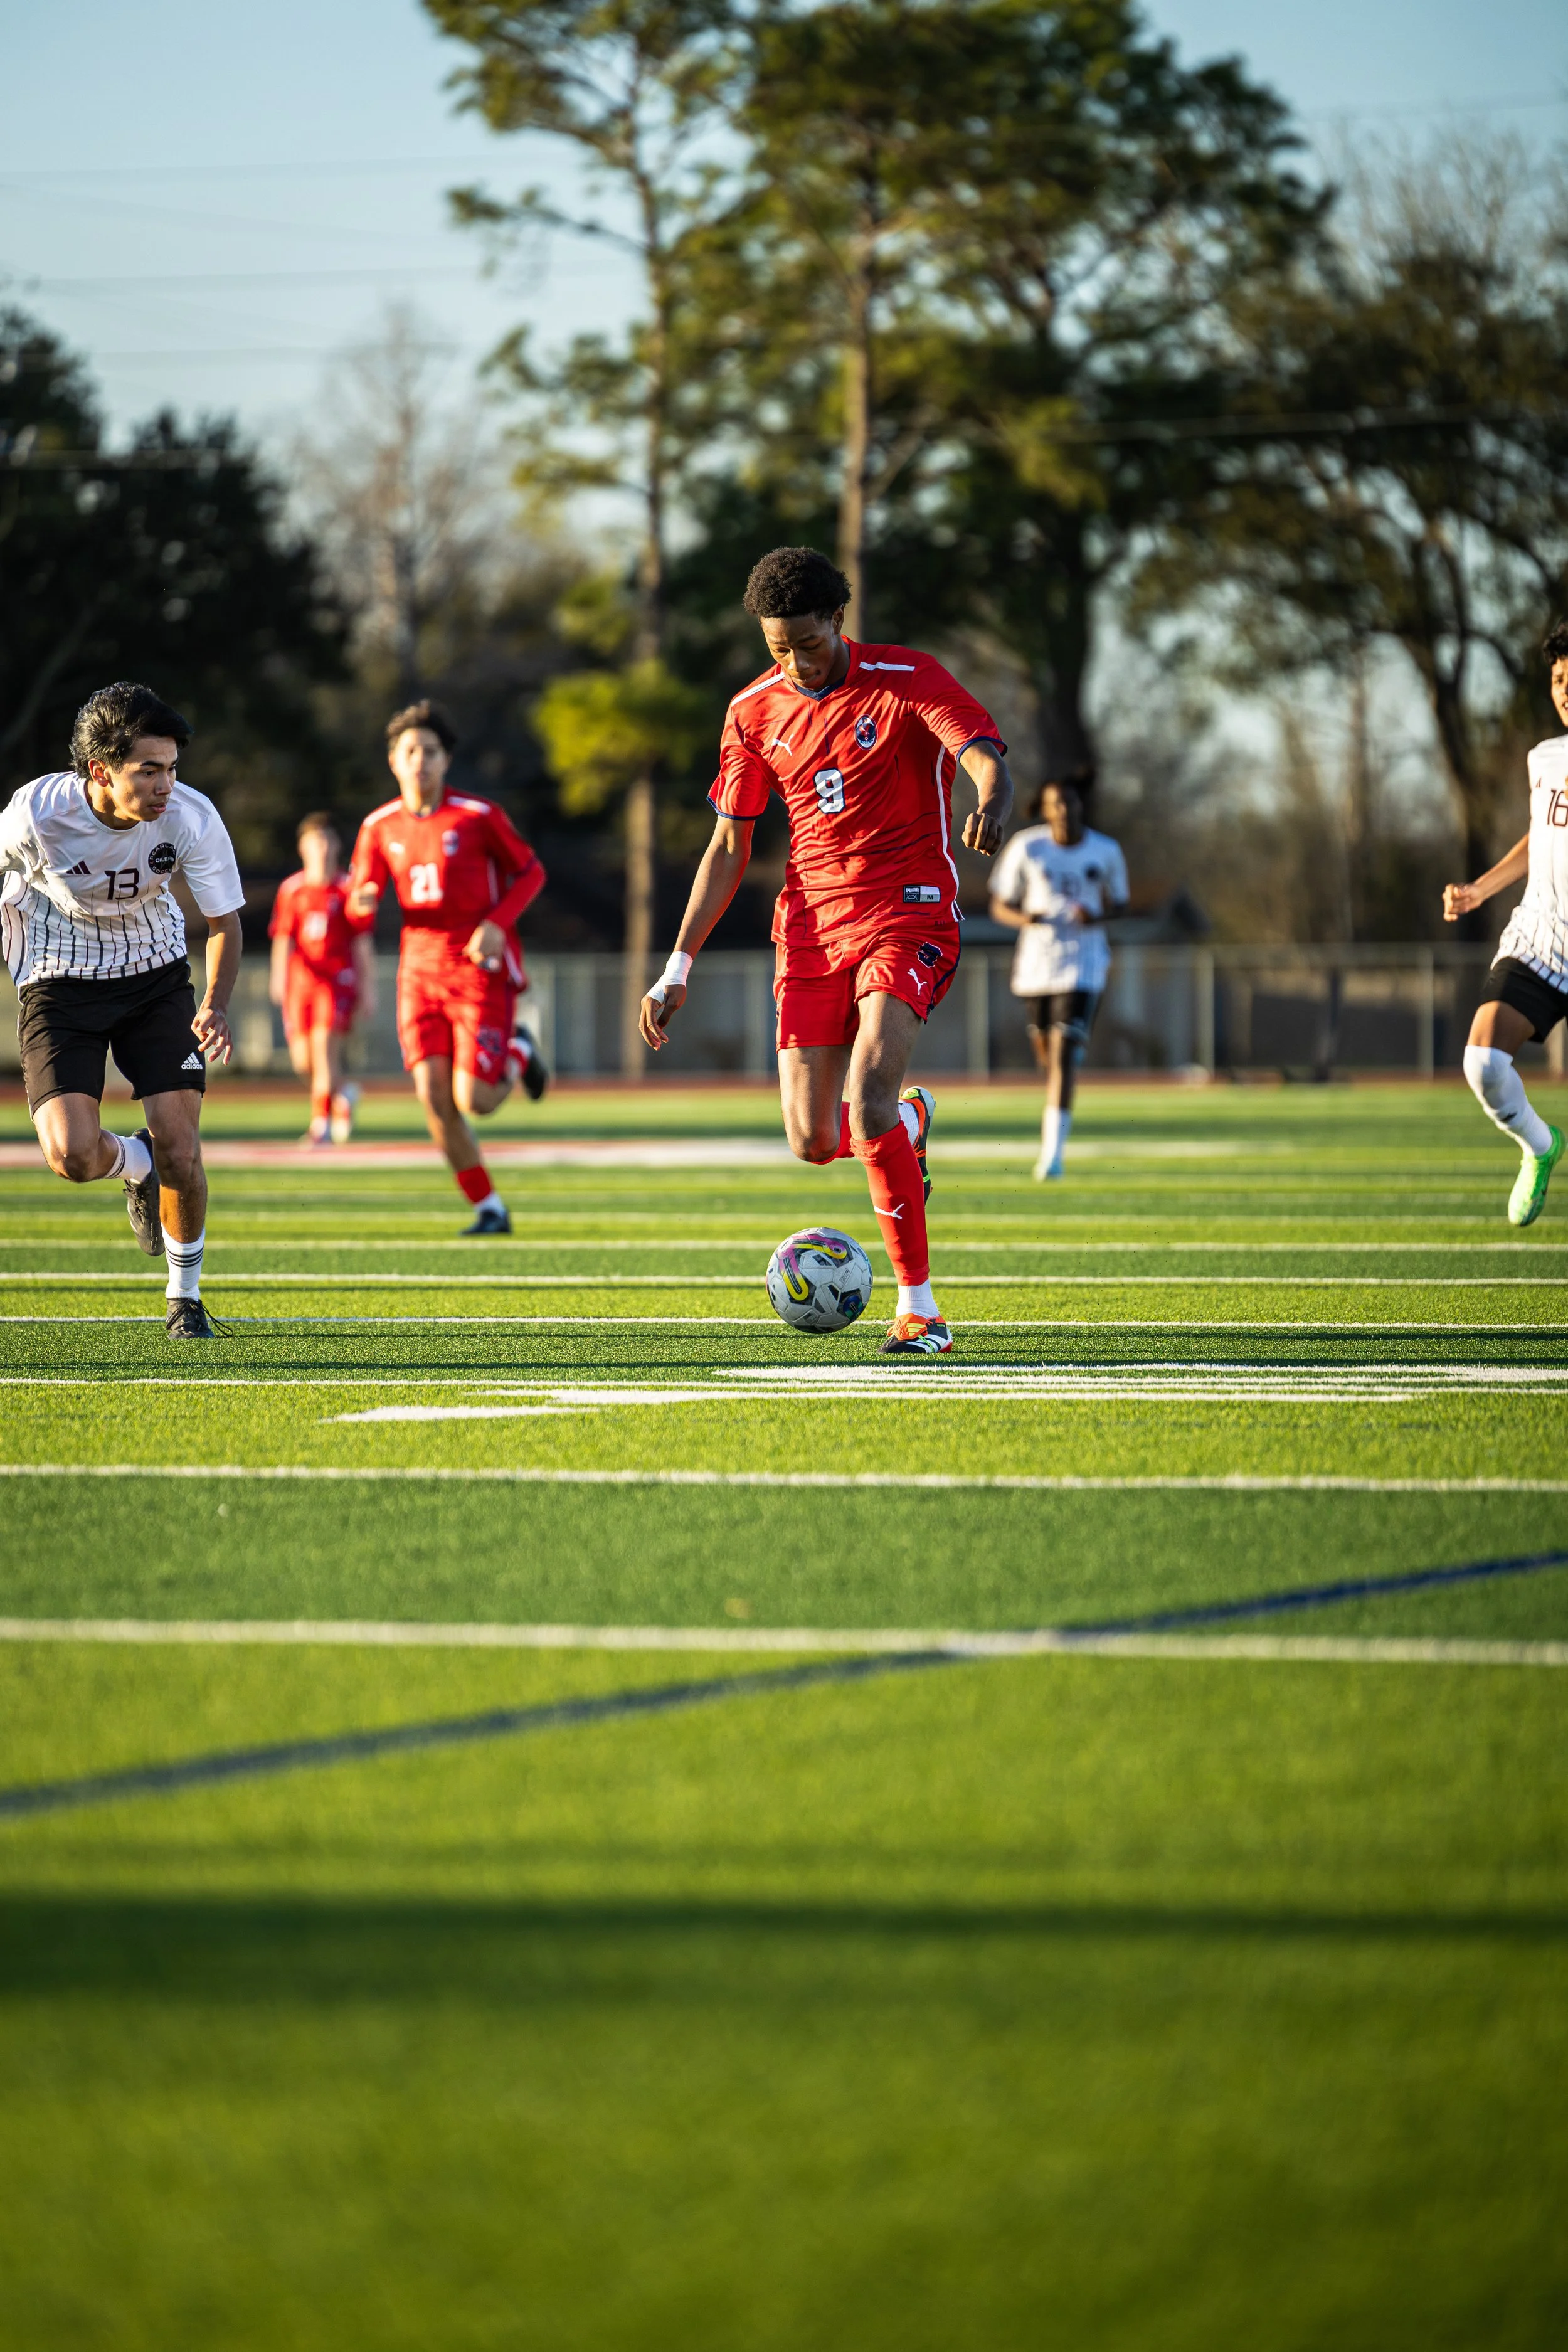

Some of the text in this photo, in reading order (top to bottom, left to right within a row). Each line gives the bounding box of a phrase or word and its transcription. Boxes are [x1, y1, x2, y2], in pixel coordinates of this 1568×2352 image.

[813, 767, 845, 814] 9
[1547, 788, 1568, 827] 16
[104, 868, 139, 900] 13
[409, 862, 444, 903] 21
